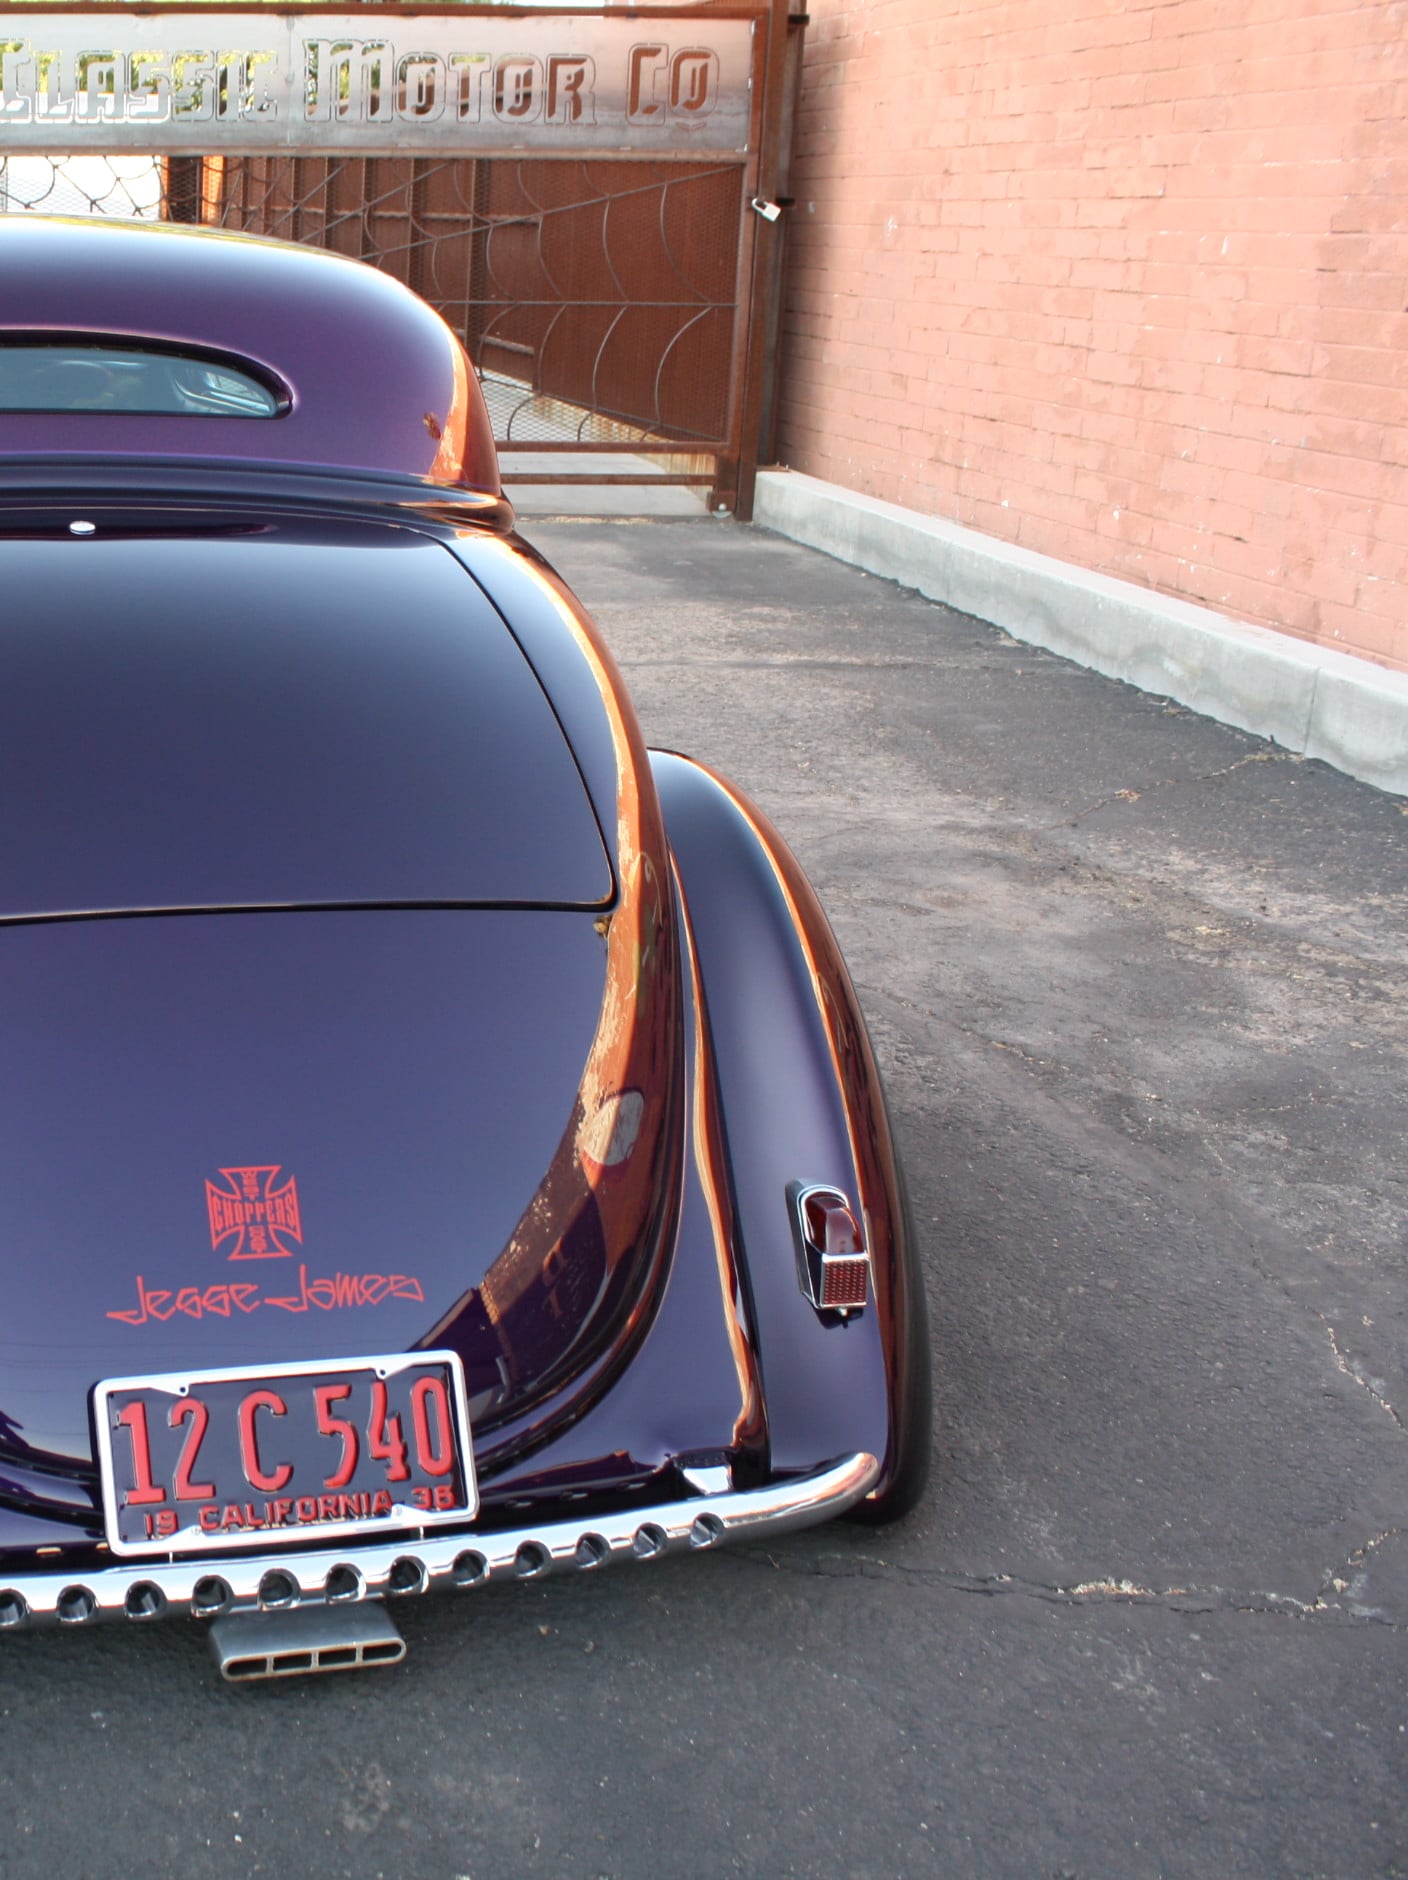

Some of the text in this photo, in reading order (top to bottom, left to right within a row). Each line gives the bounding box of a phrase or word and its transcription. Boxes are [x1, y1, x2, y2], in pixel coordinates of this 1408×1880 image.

[118, 1374, 454, 1506] 12 C 540
[198, 1489, 393, 1533] CALIFORNIA
